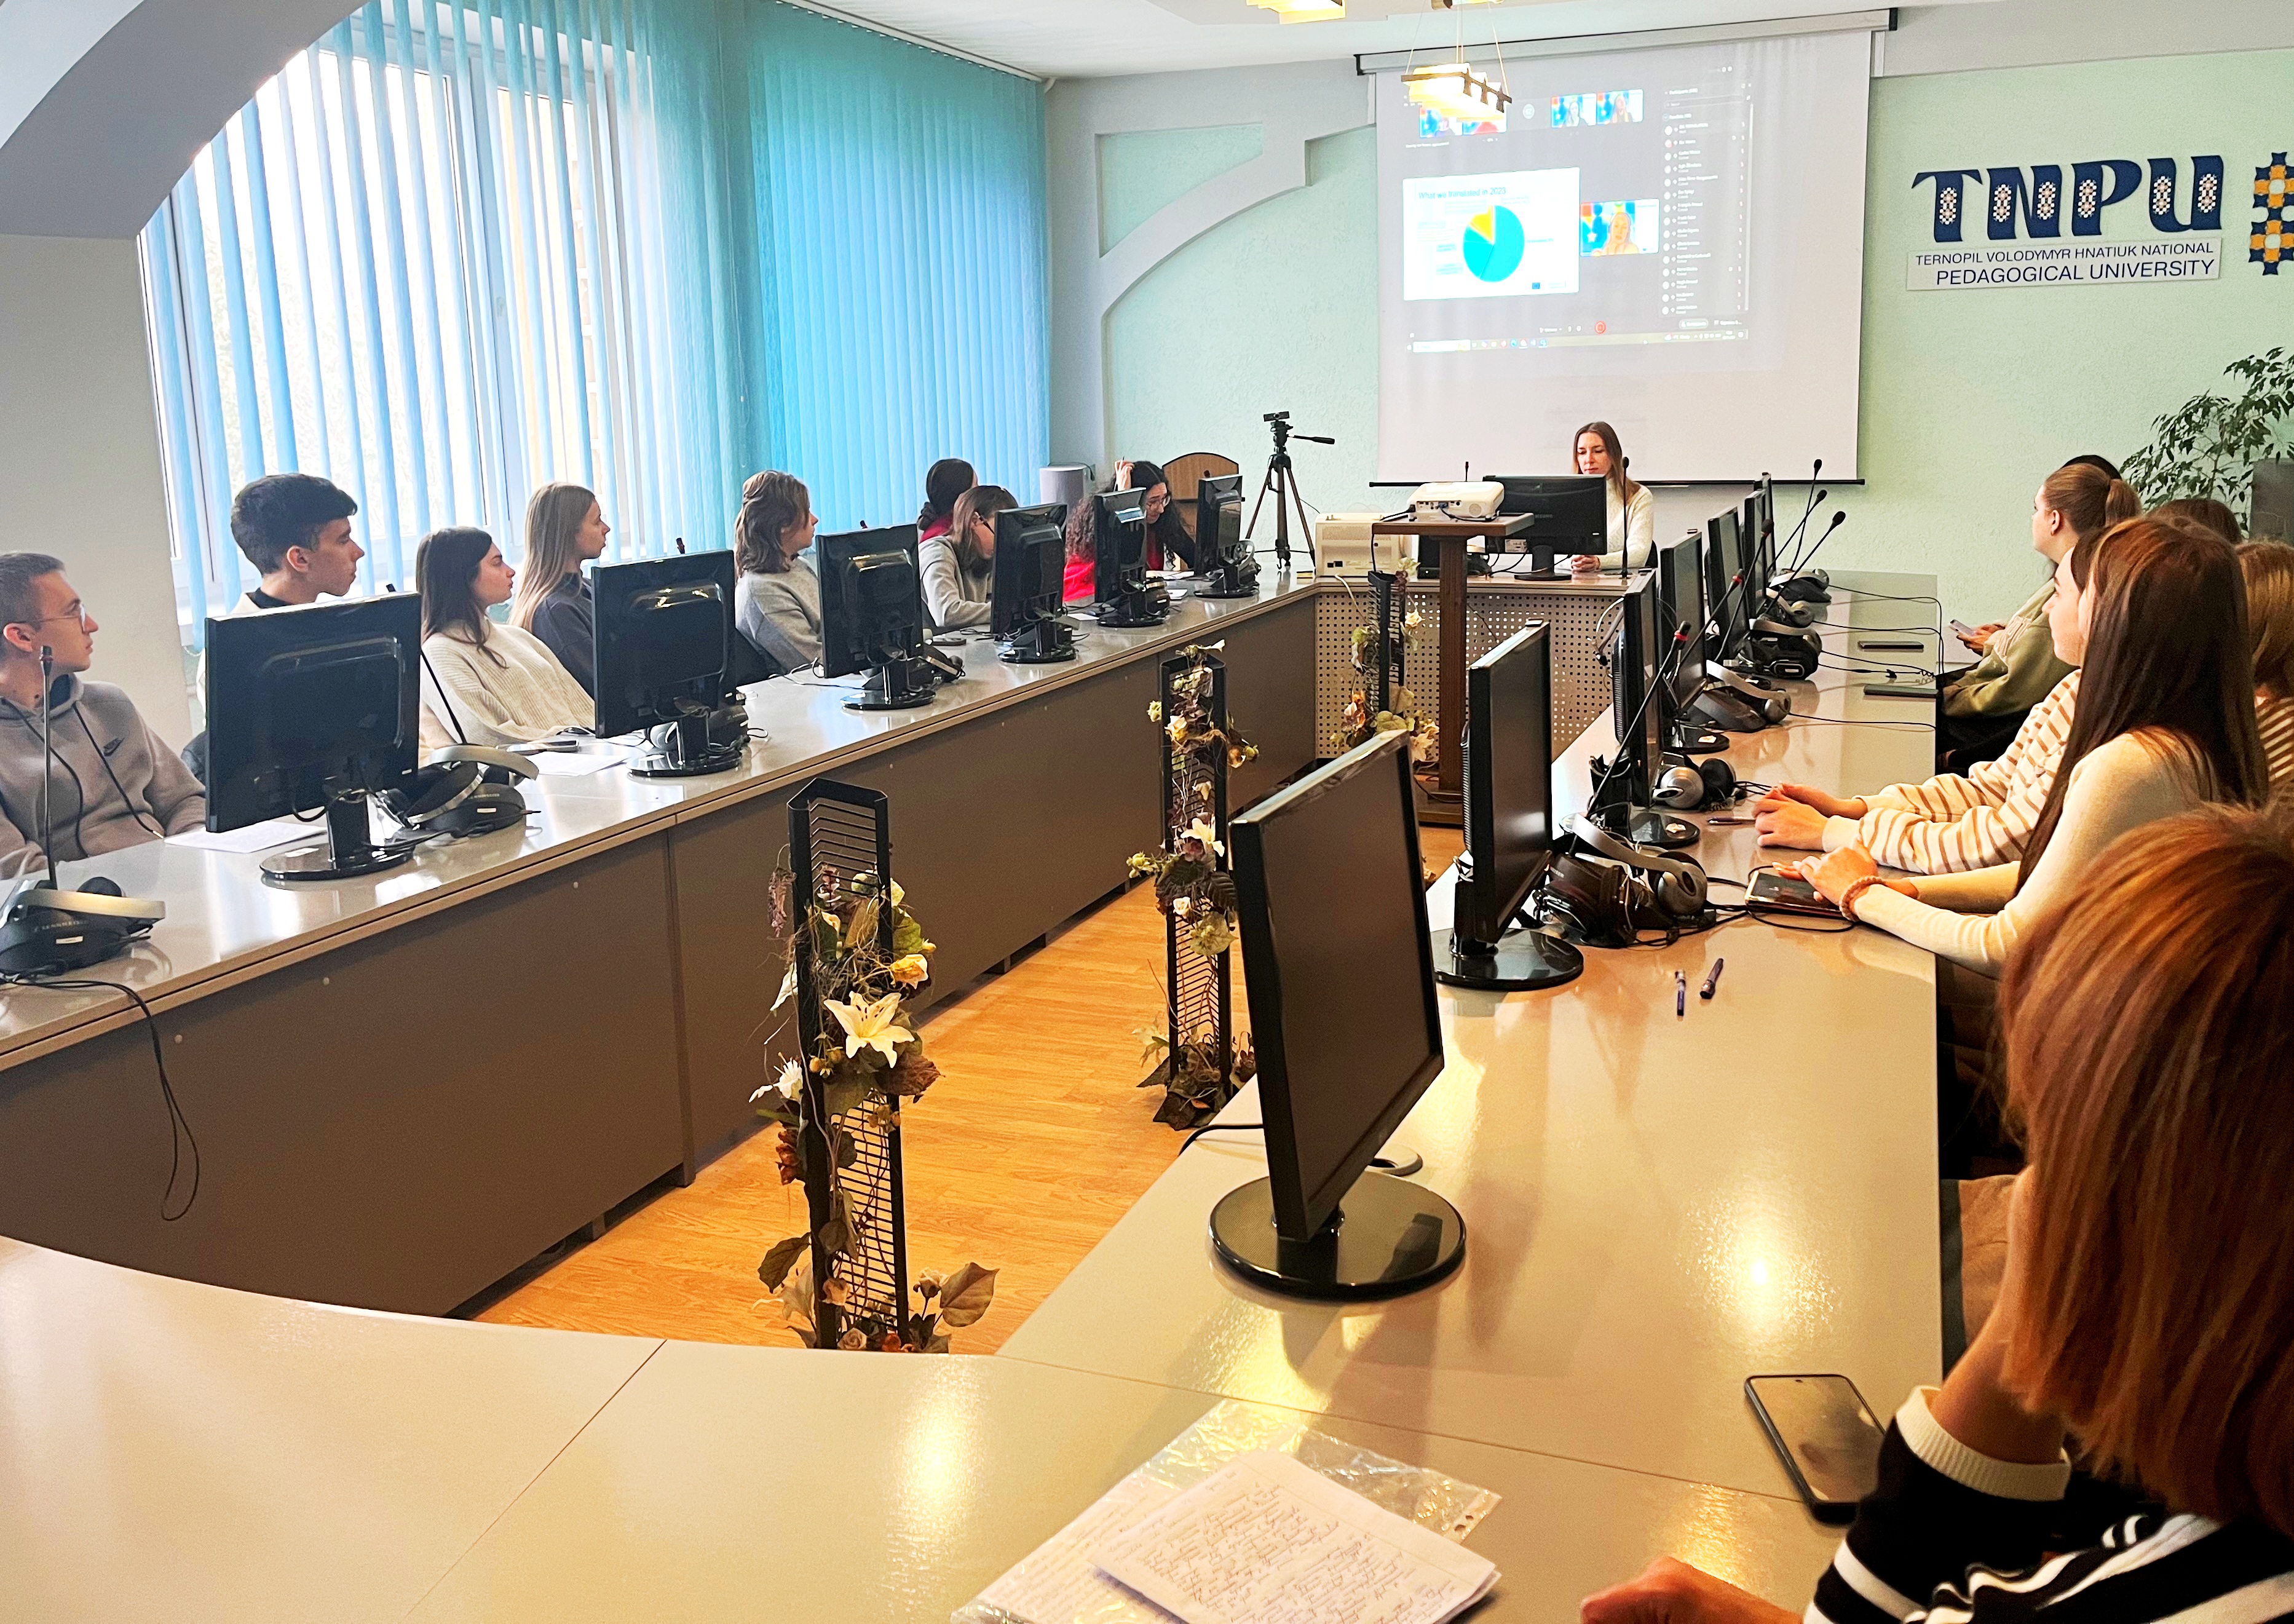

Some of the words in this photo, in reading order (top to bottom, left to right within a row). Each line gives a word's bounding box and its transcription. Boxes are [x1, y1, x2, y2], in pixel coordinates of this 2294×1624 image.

[1448, 189, 1481, 197] translated
[1911, 155, 2223, 242] TNPU
[1915, 253, 1983, 266] TERNOPIL
[1987, 248, 2071, 262] VOLODYMYR
[2075, 246, 2137, 258] HNATIUK
[2142, 242, 2213, 255] NATIONAL
[1937, 266, 2084, 285] PEDAGOGICAL
[2090, 259, 2215, 279] UNIVERSITY
